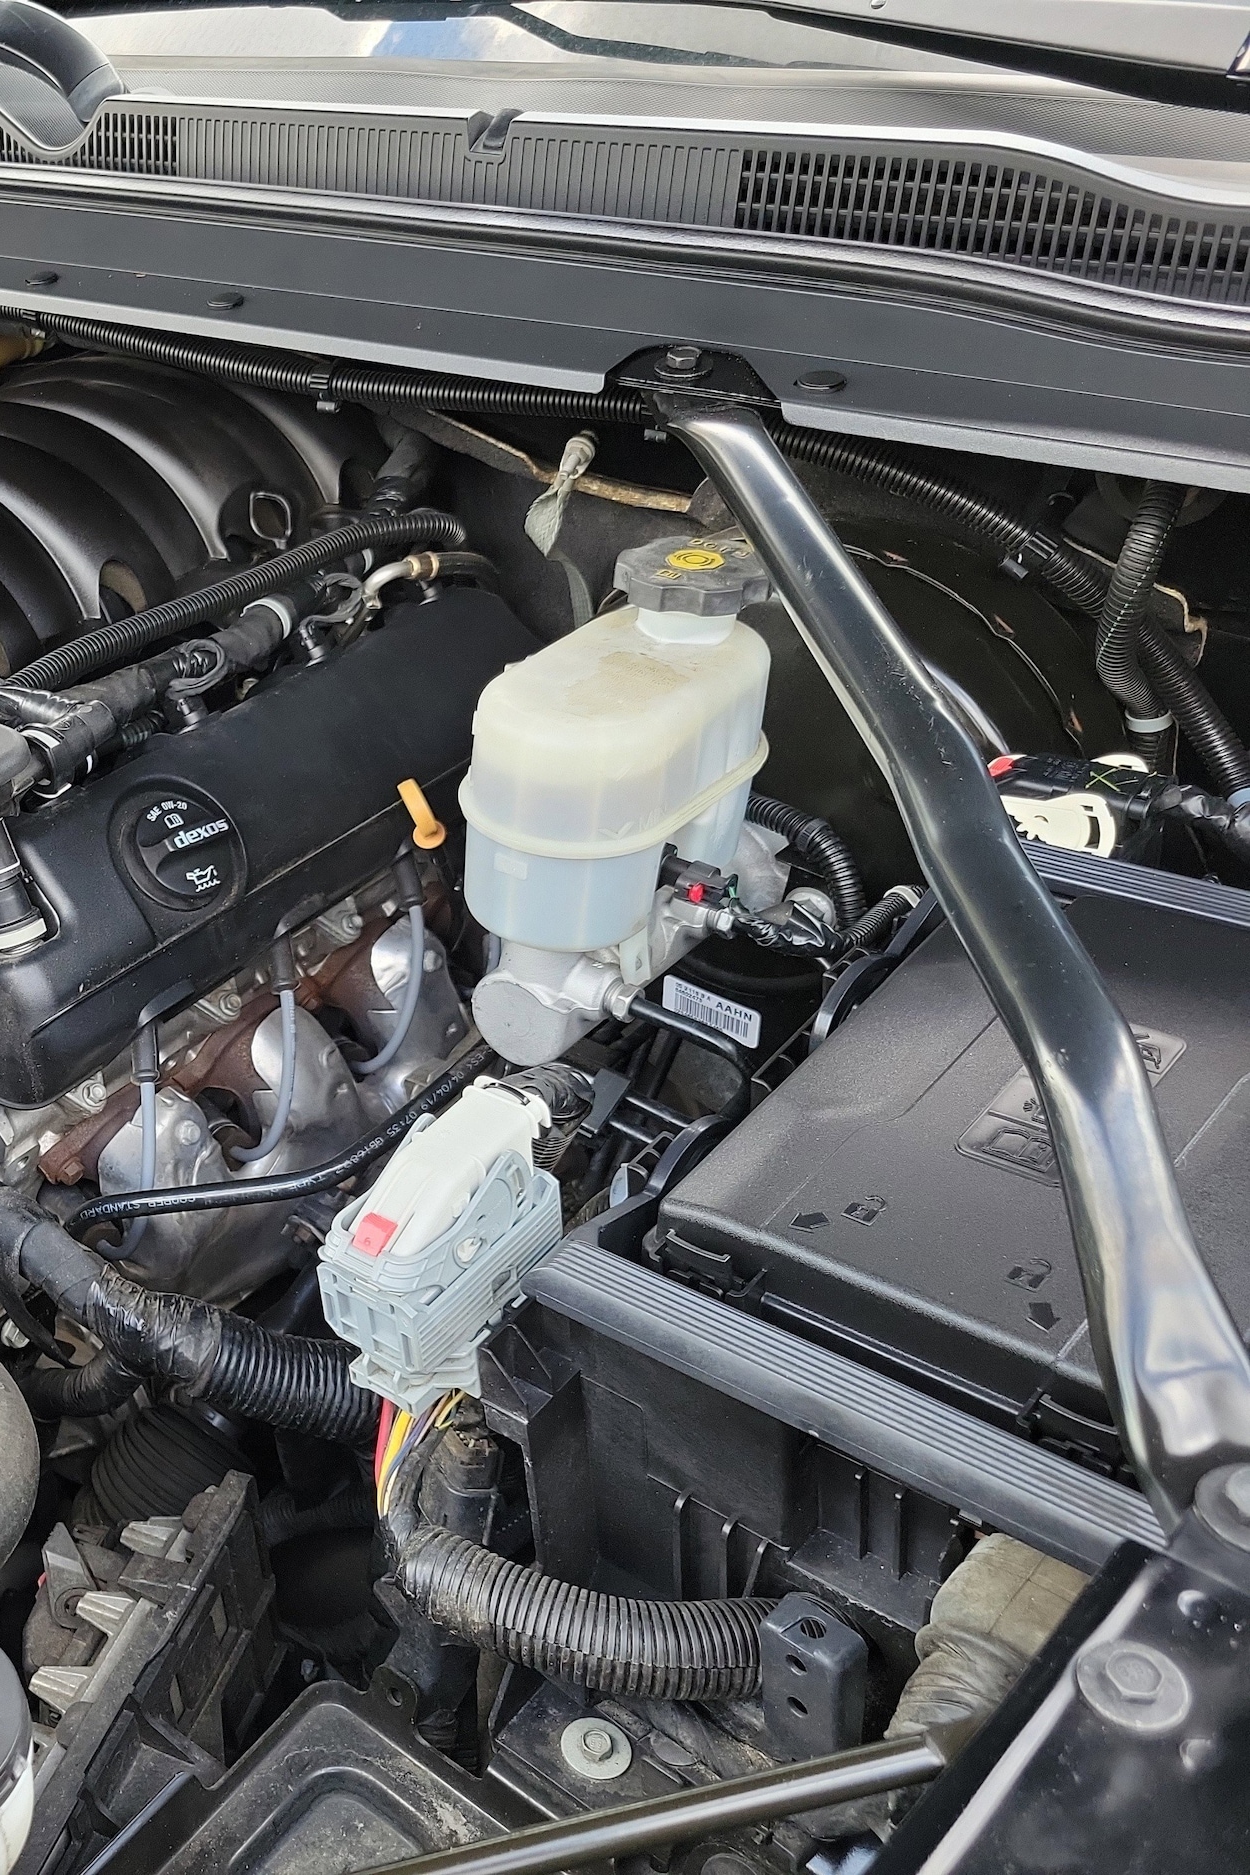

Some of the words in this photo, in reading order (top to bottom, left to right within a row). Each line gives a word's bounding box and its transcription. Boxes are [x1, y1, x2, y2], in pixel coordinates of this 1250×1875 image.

[146, 805, 162, 822] SAE
[161, 800, 188, 811] 0W-20
[173, 818, 230, 849] dexos
[715, 1001, 752, 1023] AAHN
[420, 1071, 465, 1111] 04/04/19
[386, 1111, 418, 1138] 07:35
[79, 1201, 141, 1220] STANDARD
